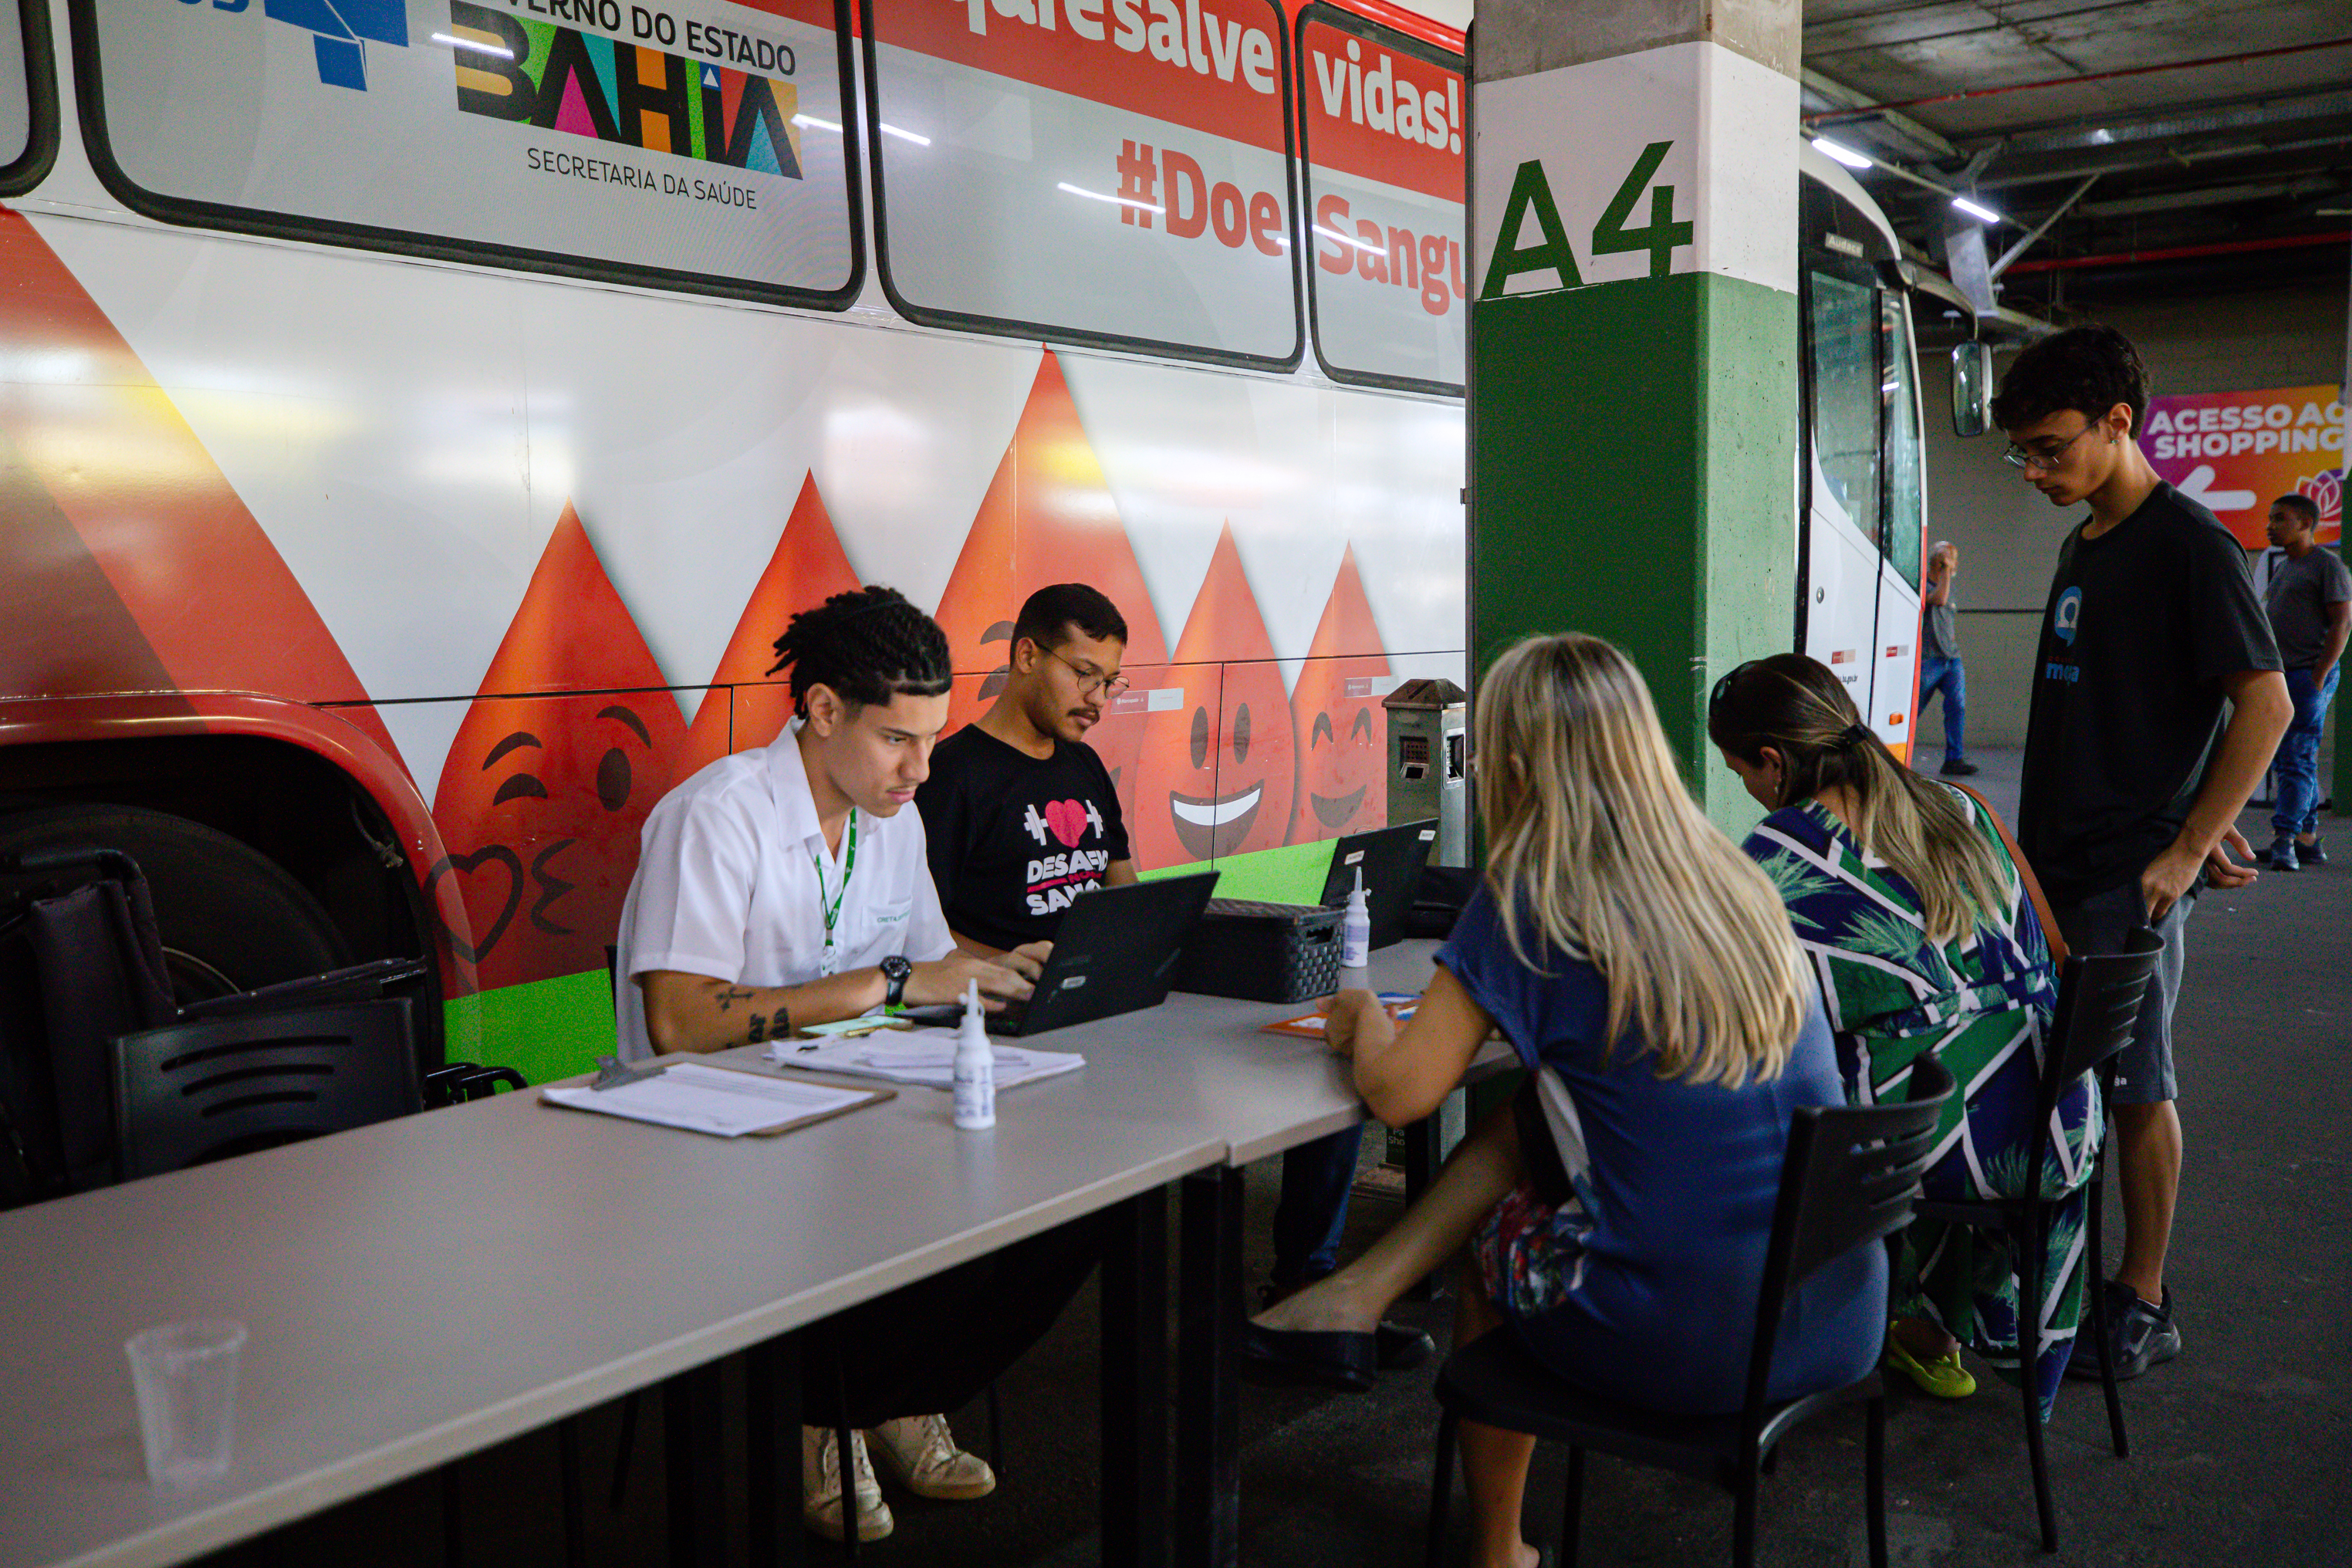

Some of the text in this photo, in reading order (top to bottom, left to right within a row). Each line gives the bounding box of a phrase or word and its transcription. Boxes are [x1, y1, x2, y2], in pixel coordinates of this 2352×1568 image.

[632, 5, 676, 46] DO
[686, 20, 796, 76] ESTADO
[450, 0, 803, 181] BAHIA
[1313, 39, 1462, 155] vidas!
[527, 147, 757, 209] SECRETARIA DA SAÚDE
[1480, 140, 1694, 299] A4
[1117, 138, 1465, 316] #Doe Sangu
[2148, 404, 2293, 435] ACESSO
[2154, 426, 2345, 460] SHOPPING
